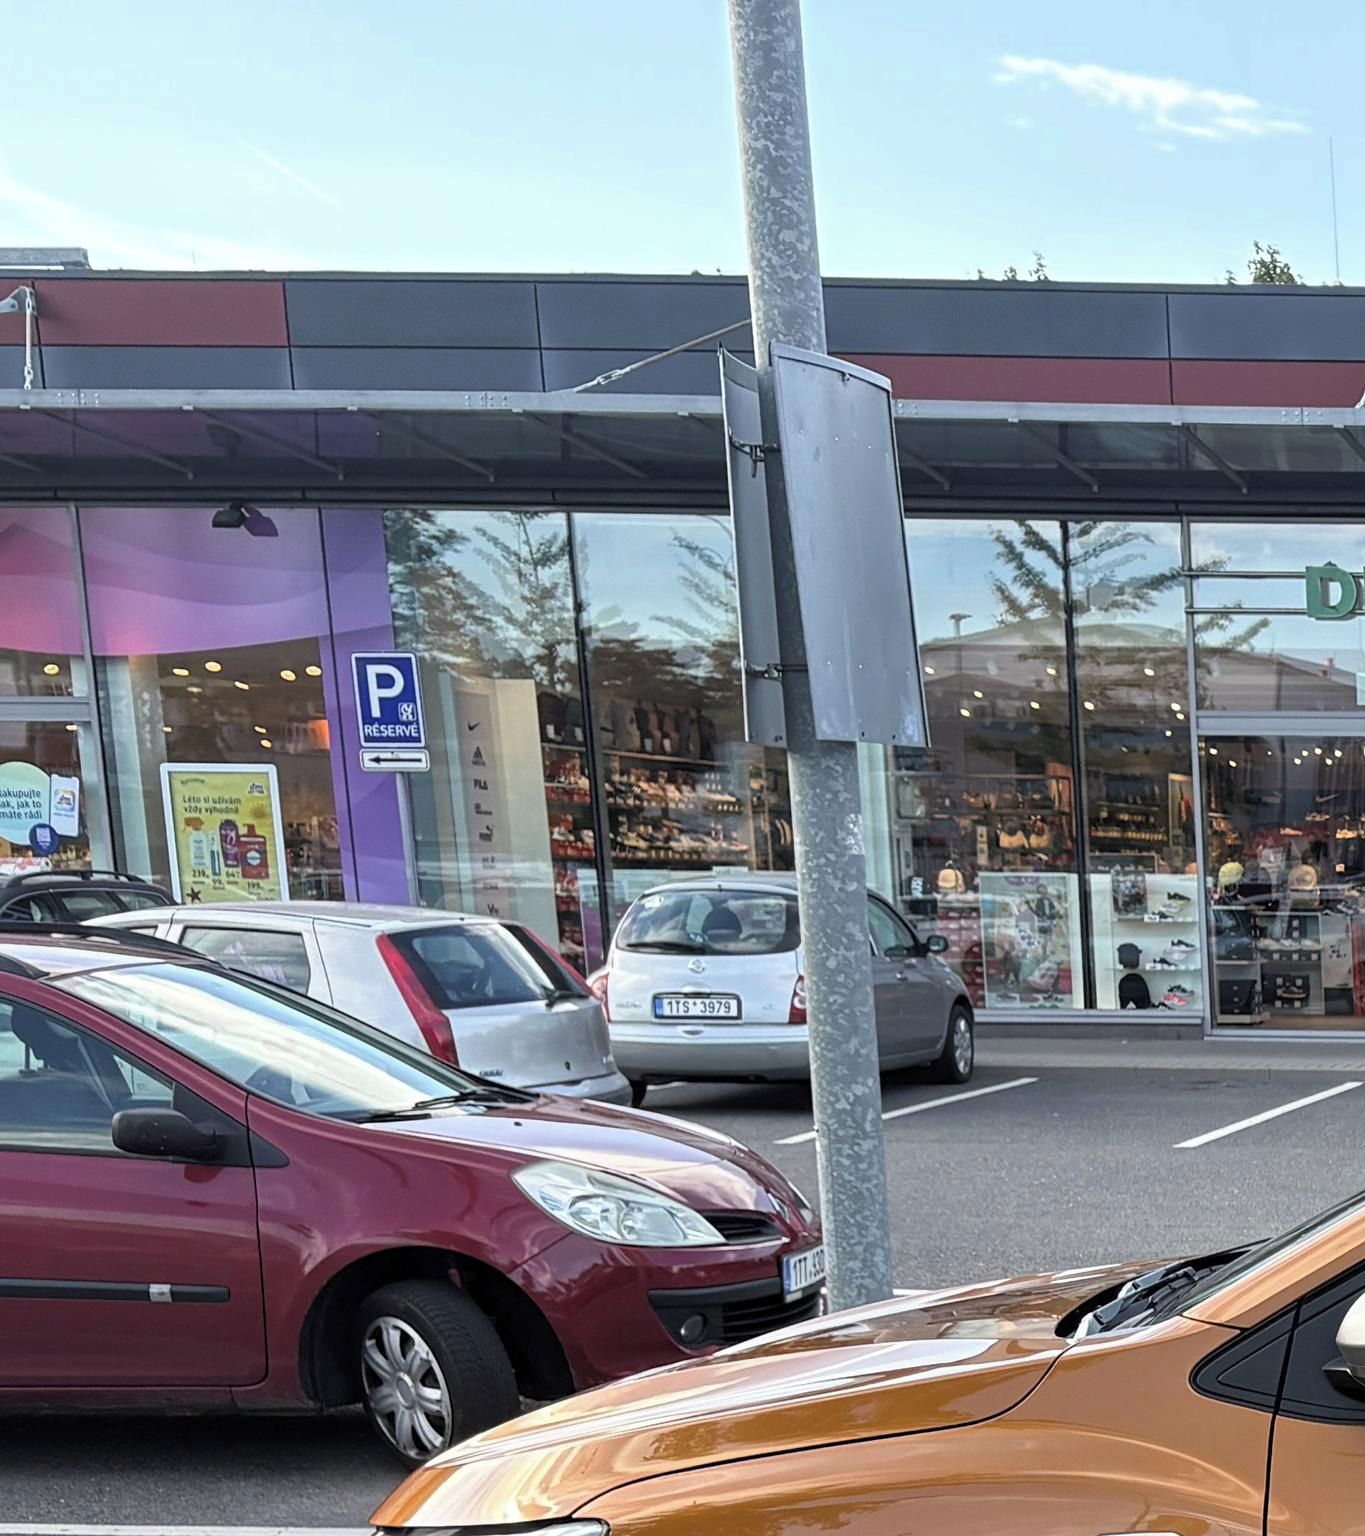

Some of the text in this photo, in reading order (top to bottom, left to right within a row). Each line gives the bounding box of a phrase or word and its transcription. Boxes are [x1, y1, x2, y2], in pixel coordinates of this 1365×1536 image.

[366, 664, 404, 718] P
[364, 722, 420, 737] RÉSERVÉ
[16, 800, 30, 810] jak
[24, 810, 42, 819] rádi
[667, 1001, 731, 1013] 1TS 3979
